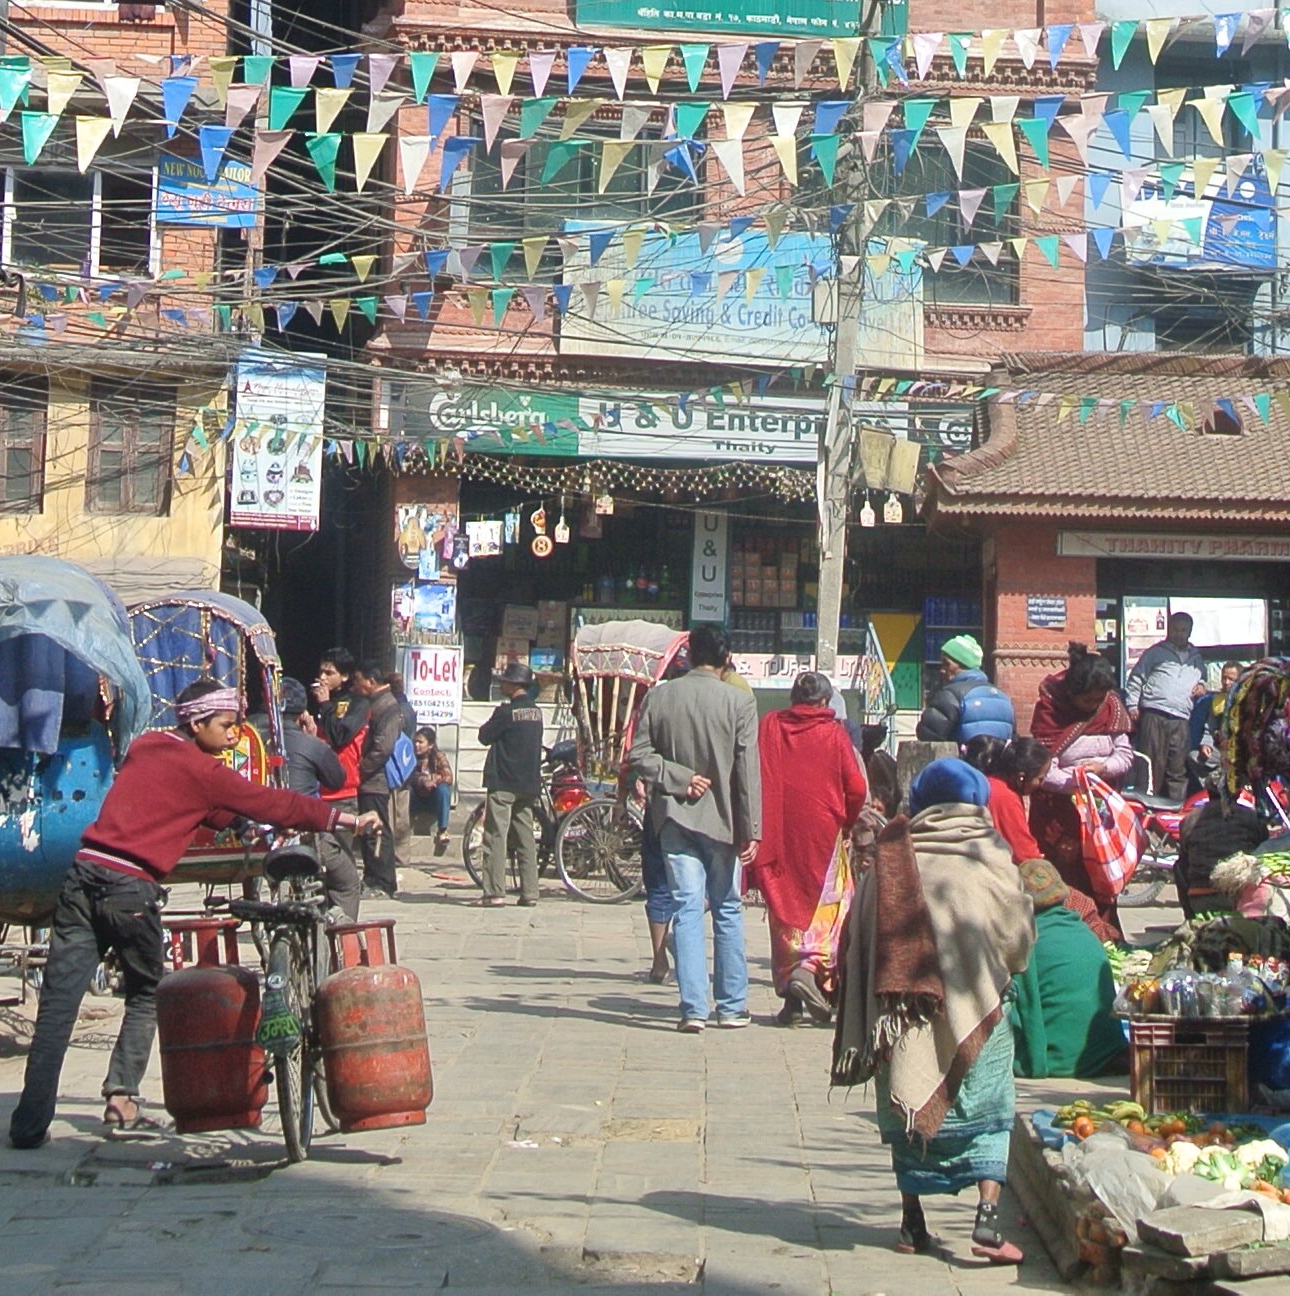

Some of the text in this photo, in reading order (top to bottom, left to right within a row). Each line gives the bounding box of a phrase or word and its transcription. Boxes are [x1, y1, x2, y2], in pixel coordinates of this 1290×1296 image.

[164, 161, 184, 177] NEW
[428, 392, 548, 432] Carlsberg
[701, 564, 716, 582] U
[411, 651, 457, 682] To-Let
